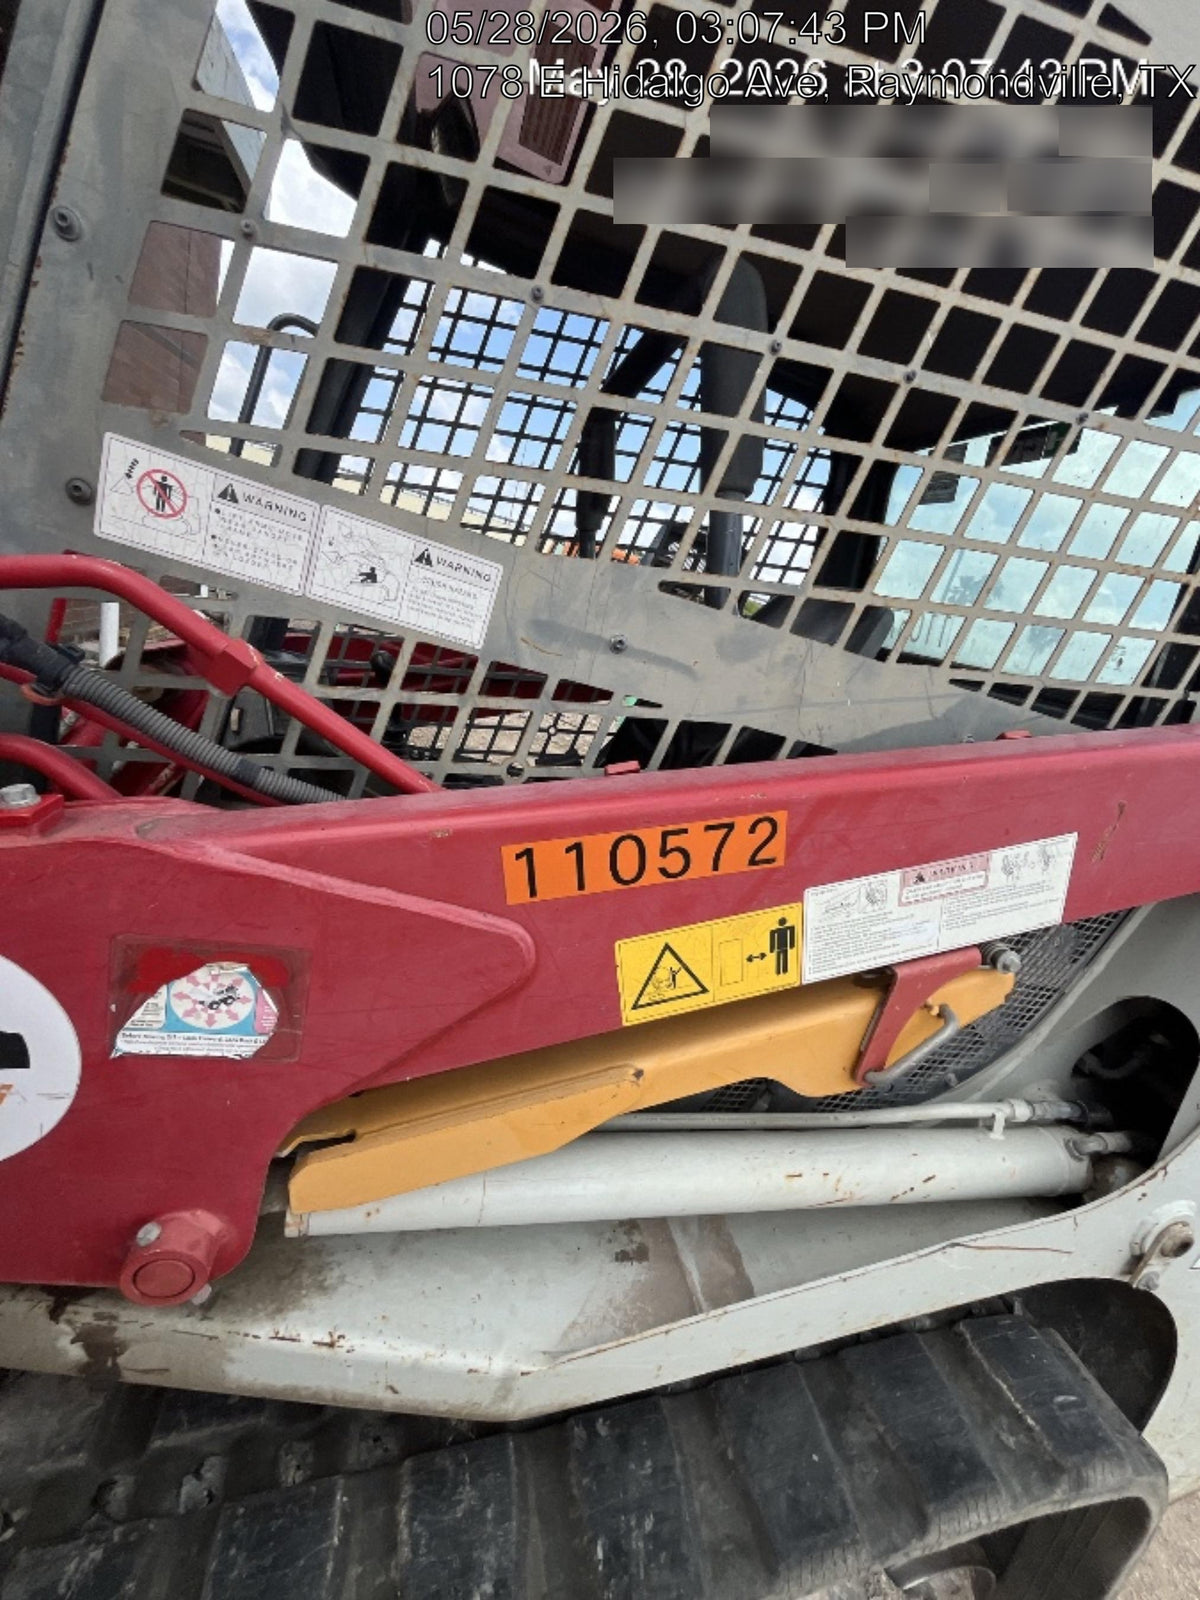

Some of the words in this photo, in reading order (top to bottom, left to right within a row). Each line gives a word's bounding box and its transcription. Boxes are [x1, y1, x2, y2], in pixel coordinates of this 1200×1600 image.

[242, 492, 307, 522] WARNING
[436, 556, 492, 583] WARNING
[513, 814, 780, 900] 110572
